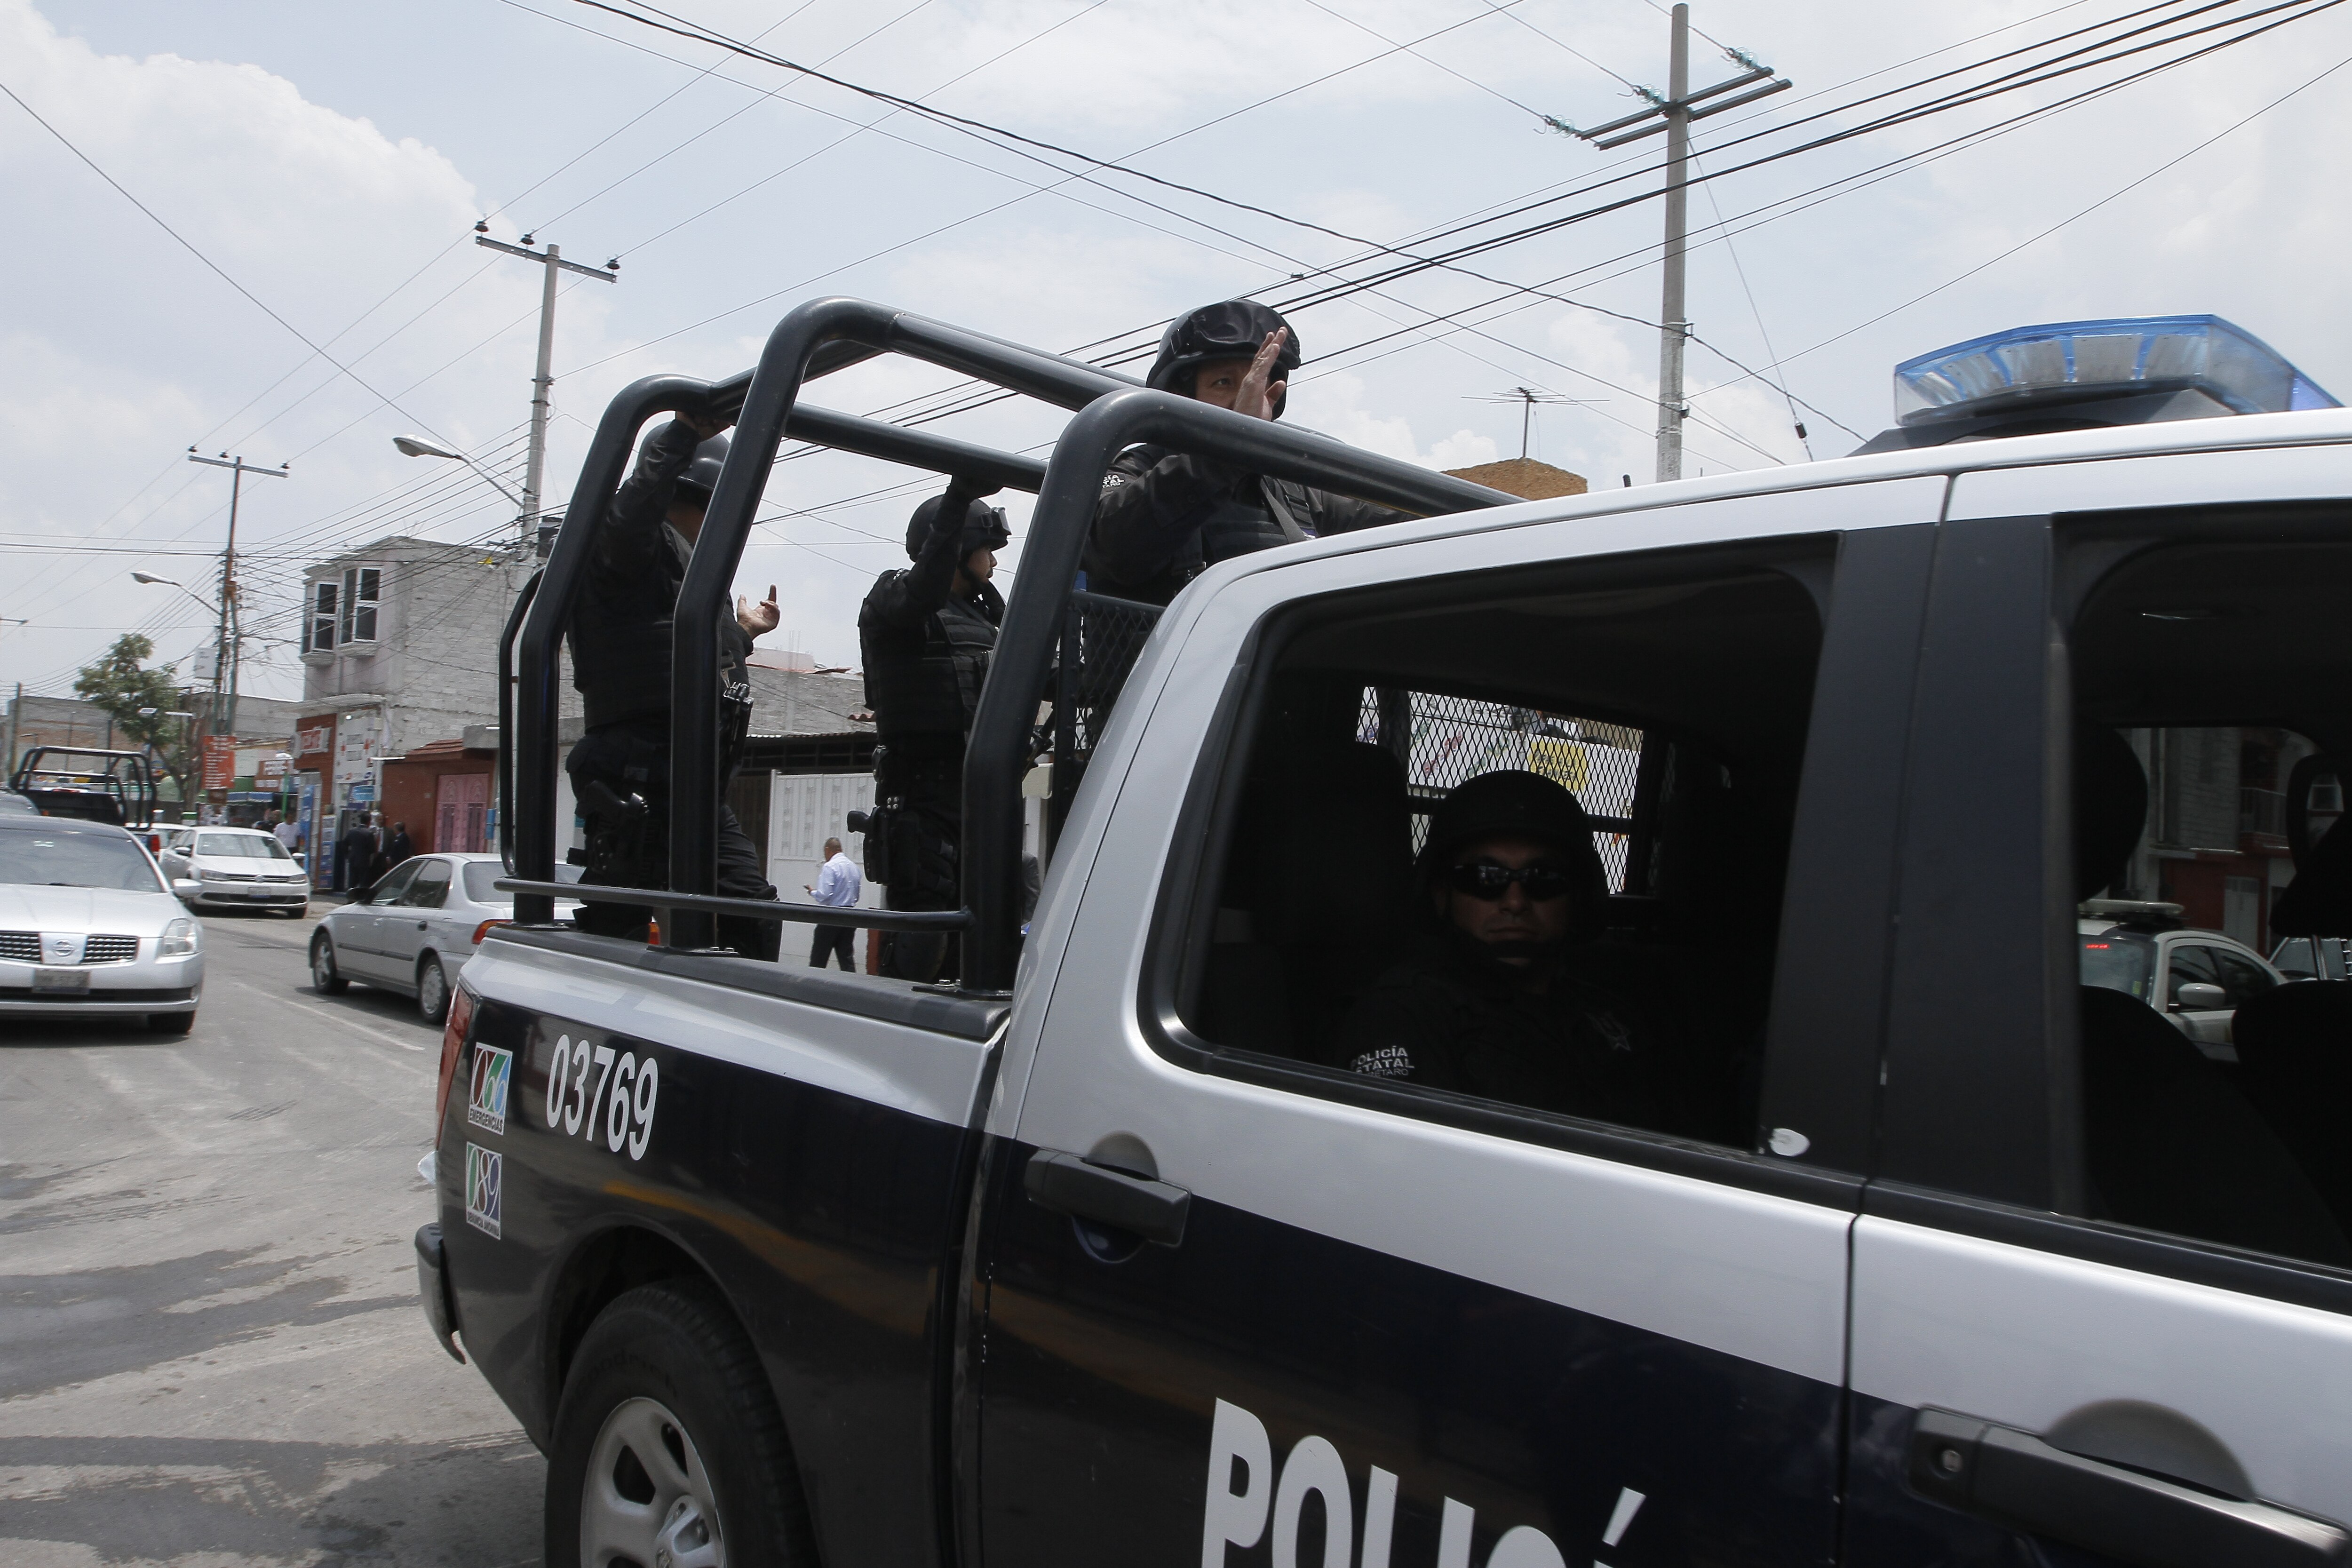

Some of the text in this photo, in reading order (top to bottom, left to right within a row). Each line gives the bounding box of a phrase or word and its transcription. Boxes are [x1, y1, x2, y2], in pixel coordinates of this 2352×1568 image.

[471, 1049, 510, 1115] 066
[547, 1035, 658, 1161] 03769
[467, 1146, 500, 1218] 089
